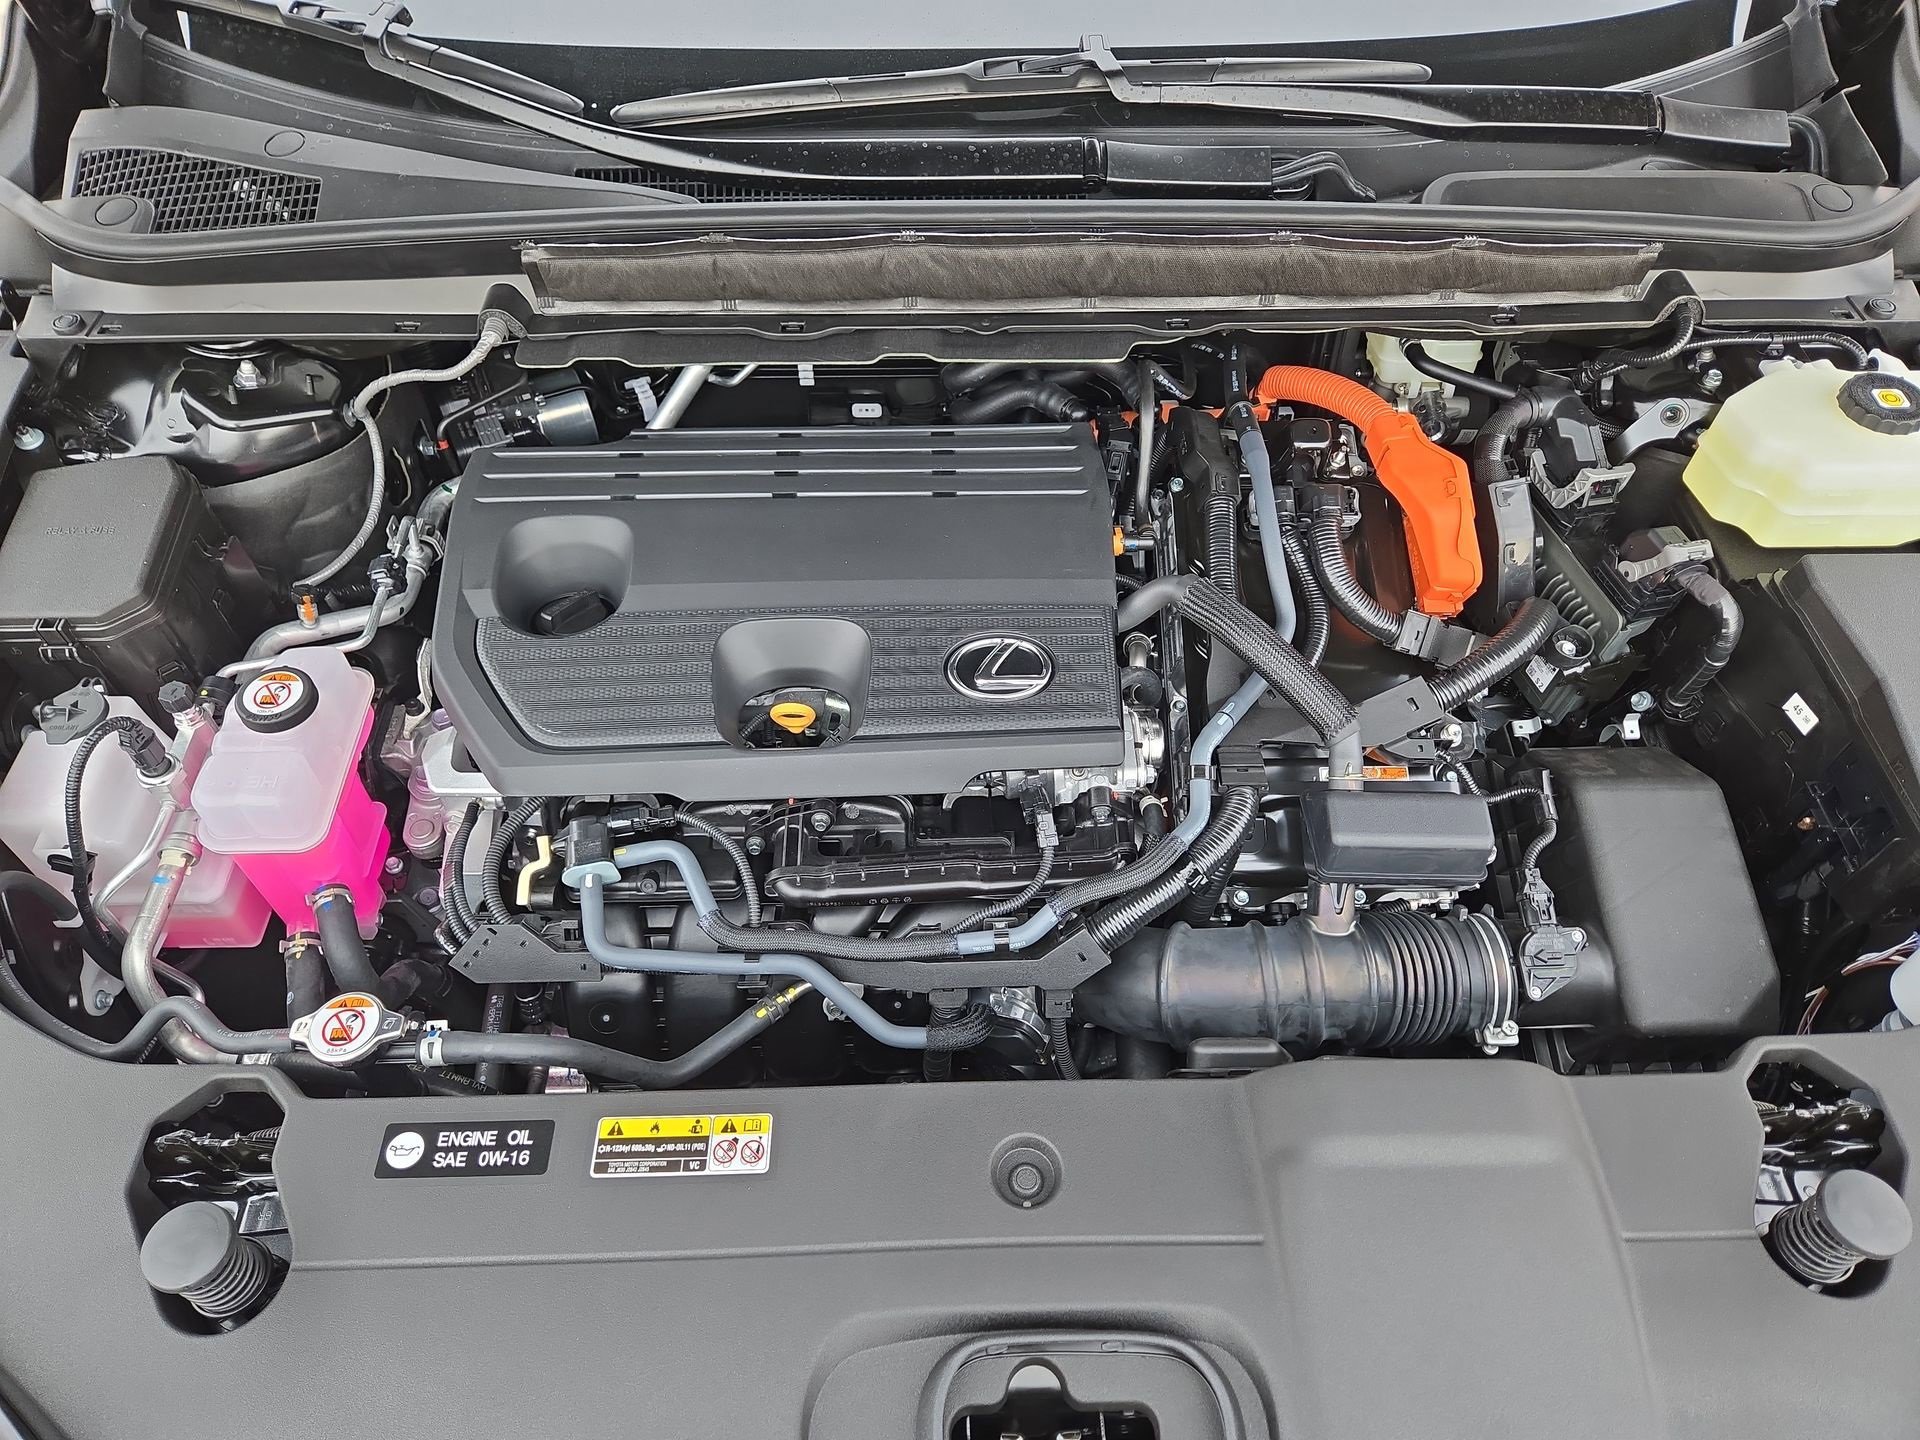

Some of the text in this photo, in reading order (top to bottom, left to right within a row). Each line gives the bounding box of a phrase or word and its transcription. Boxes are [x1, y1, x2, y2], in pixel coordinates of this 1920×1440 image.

[1793, 704, 1804, 716] 45
[437, 1130, 534, 1147] ENGINE OIL
[432, 1150, 530, 1168] SAE 0W-16
[689, 1161, 700, 1170] VC
